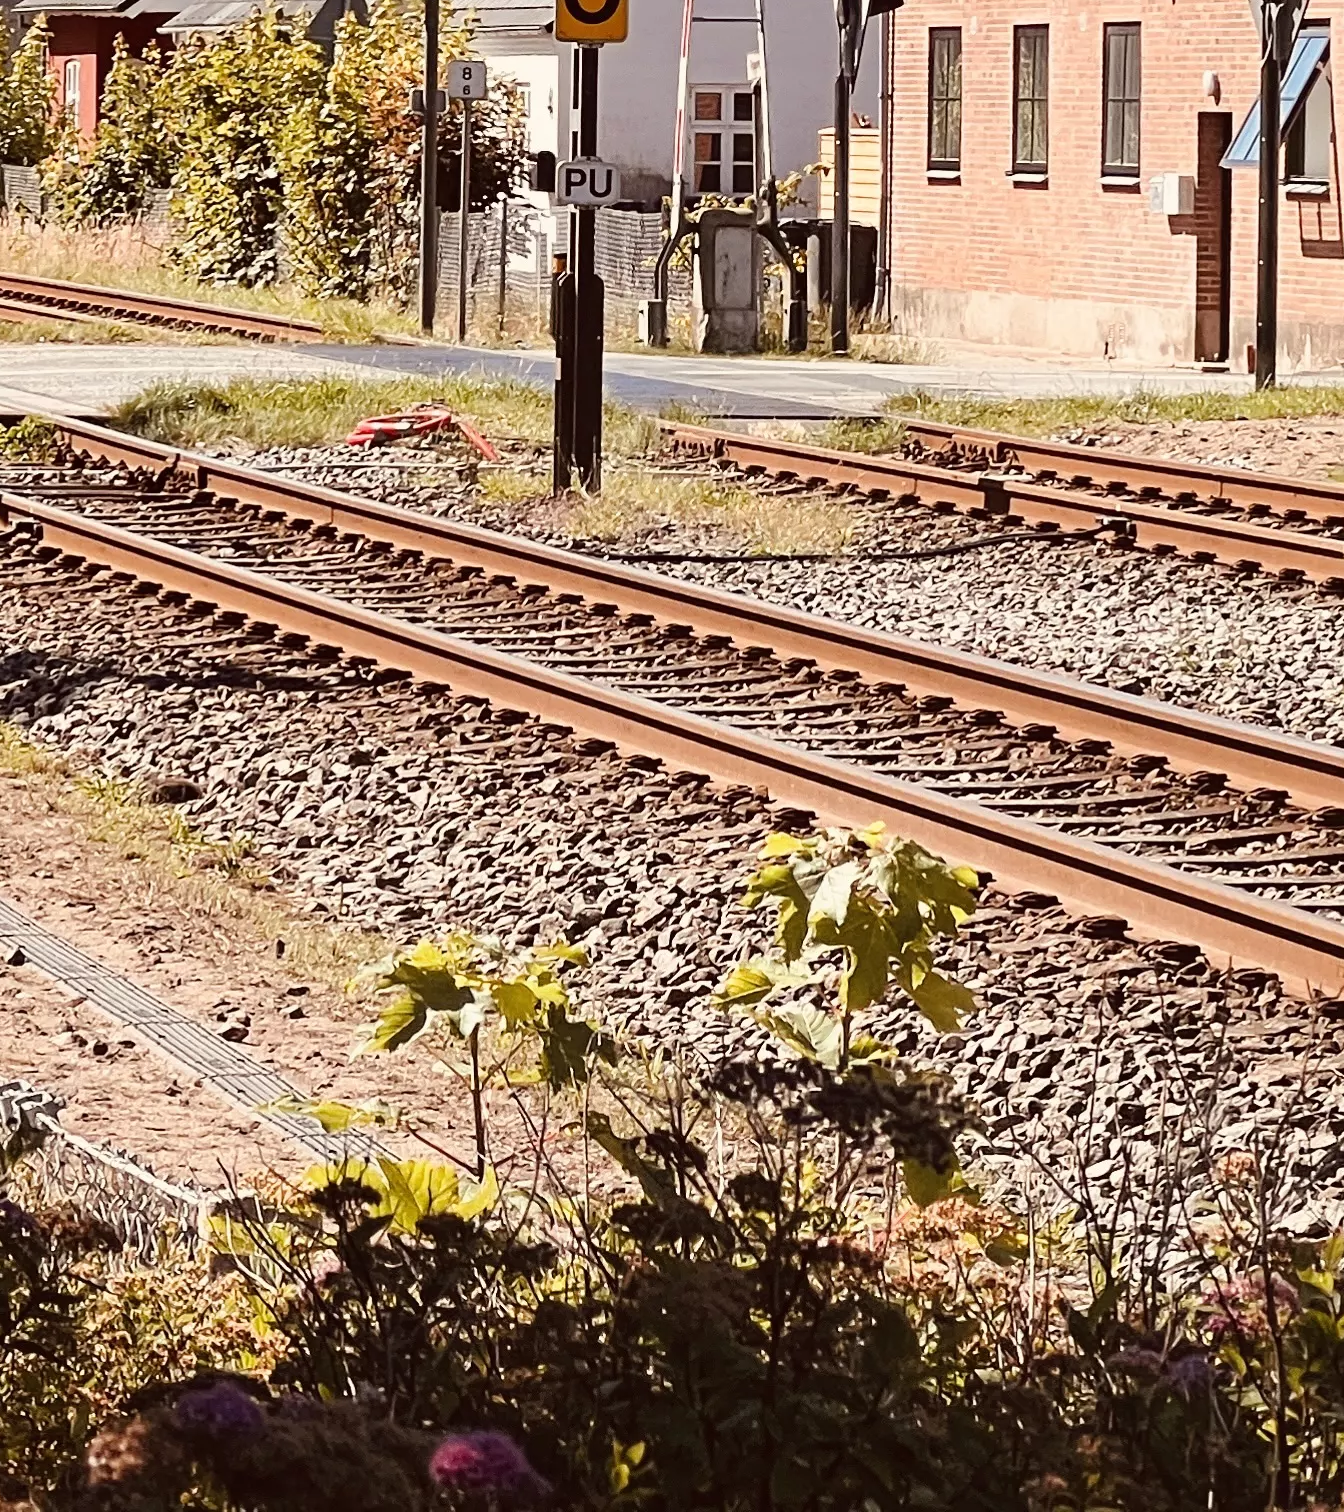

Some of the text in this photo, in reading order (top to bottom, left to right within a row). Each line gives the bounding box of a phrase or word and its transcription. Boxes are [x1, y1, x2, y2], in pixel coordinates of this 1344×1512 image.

[462, 67, 472, 81] 8
[462, 84, 471, 96] 6
[565, 168, 612, 198] PU
